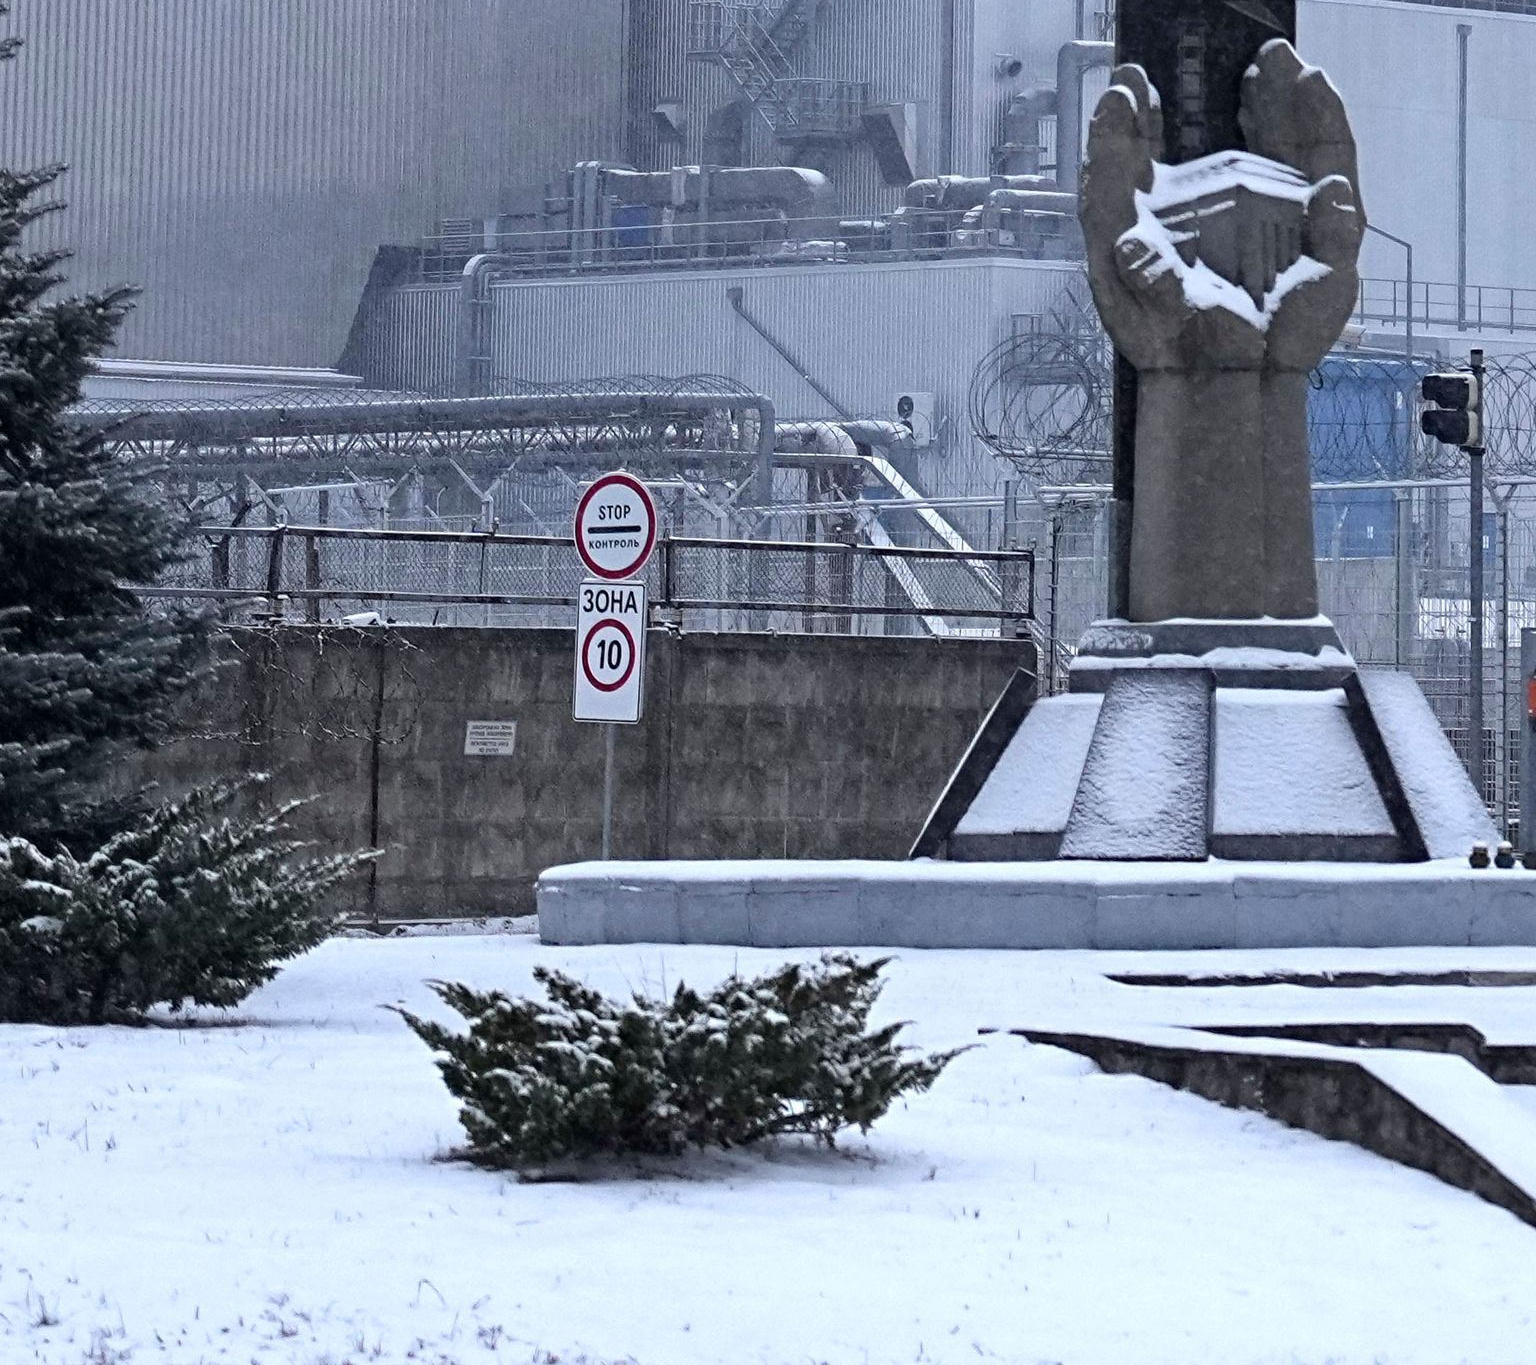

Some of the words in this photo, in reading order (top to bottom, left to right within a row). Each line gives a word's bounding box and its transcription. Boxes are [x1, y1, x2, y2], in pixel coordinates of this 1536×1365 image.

[598, 504, 631, 520] STOP
[589, 539, 640, 549] КОНТРОЛЬ
[583, 589, 638, 614] ЗОНА
[597, 639, 622, 670] 10
